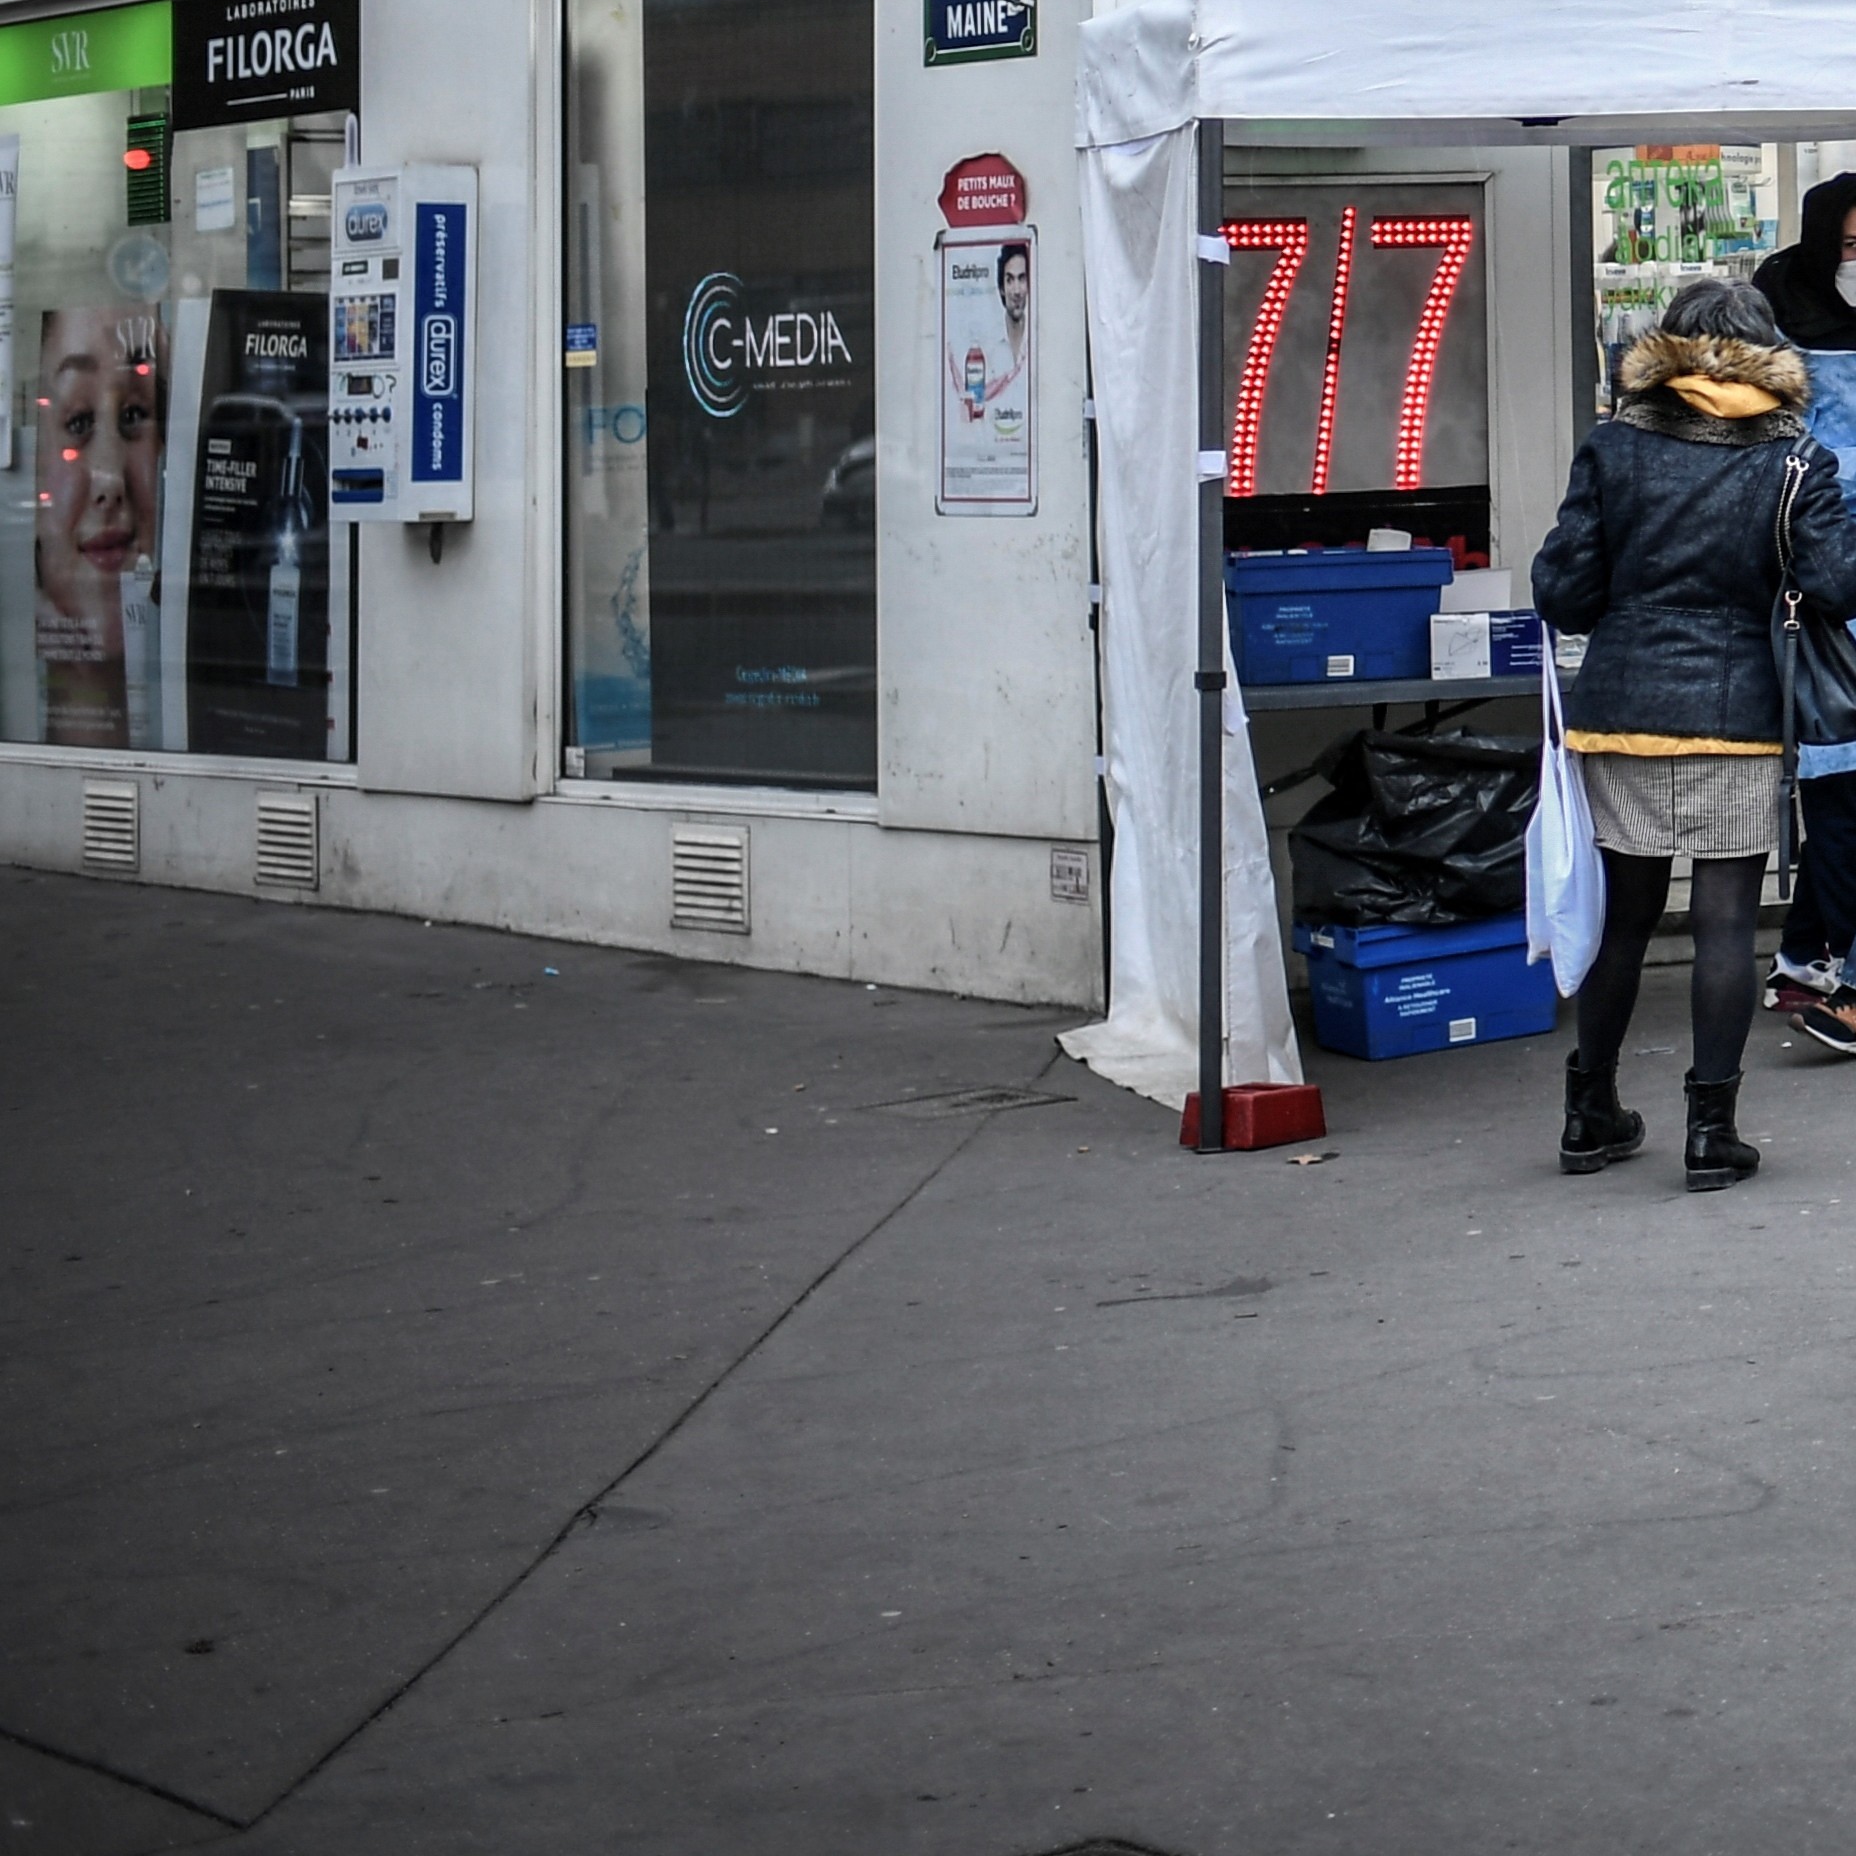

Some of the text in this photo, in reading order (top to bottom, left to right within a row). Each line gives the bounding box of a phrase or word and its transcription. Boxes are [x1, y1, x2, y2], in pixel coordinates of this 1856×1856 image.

[946, 1, 1009, 39] MAINE
[51, 29, 90, 74] SVR
[207, 21, 338, 82] FILORGA
[957, 194, 1016, 211] DE BOUCHE ?
[958, 175, 1016, 191] PETITS MAUX
[348, 208, 386, 236] durex
[433, 213, 449, 309] préservatifs
[245, 333, 308, 358] FILORGA
[430, 321, 447, 390] durex
[708, 310, 853, 370] C-MEDIA
[1217, 206, 1473, 497] 7/7
[432, 402, 446, 472] condoms
[205, 475, 248, 494] INTENSIVE
[206, 458, 257, 478] TIME-FILLER
